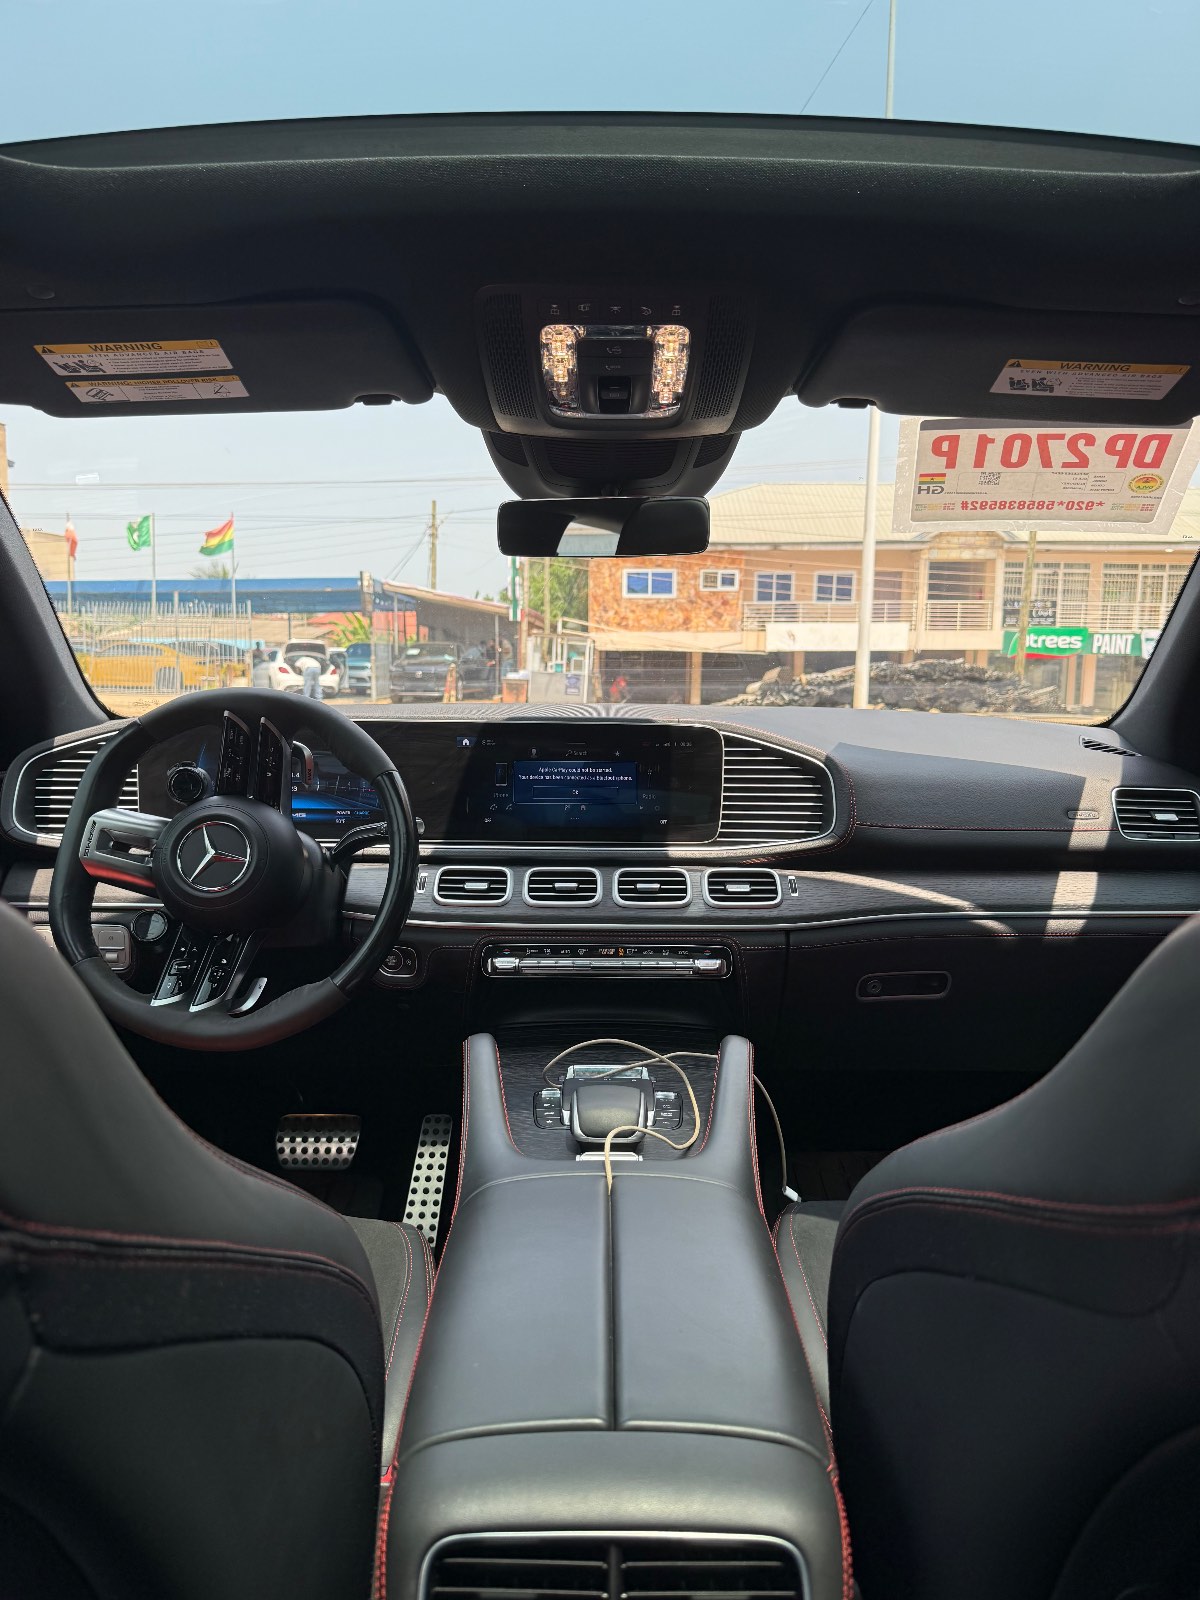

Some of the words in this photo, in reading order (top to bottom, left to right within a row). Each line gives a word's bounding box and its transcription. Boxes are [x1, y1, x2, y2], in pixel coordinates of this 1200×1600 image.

[88, 342, 163, 353] WARNING
[1059, 362, 1132, 372] WARNING
[1092, 633, 1135, 655] PAINT
